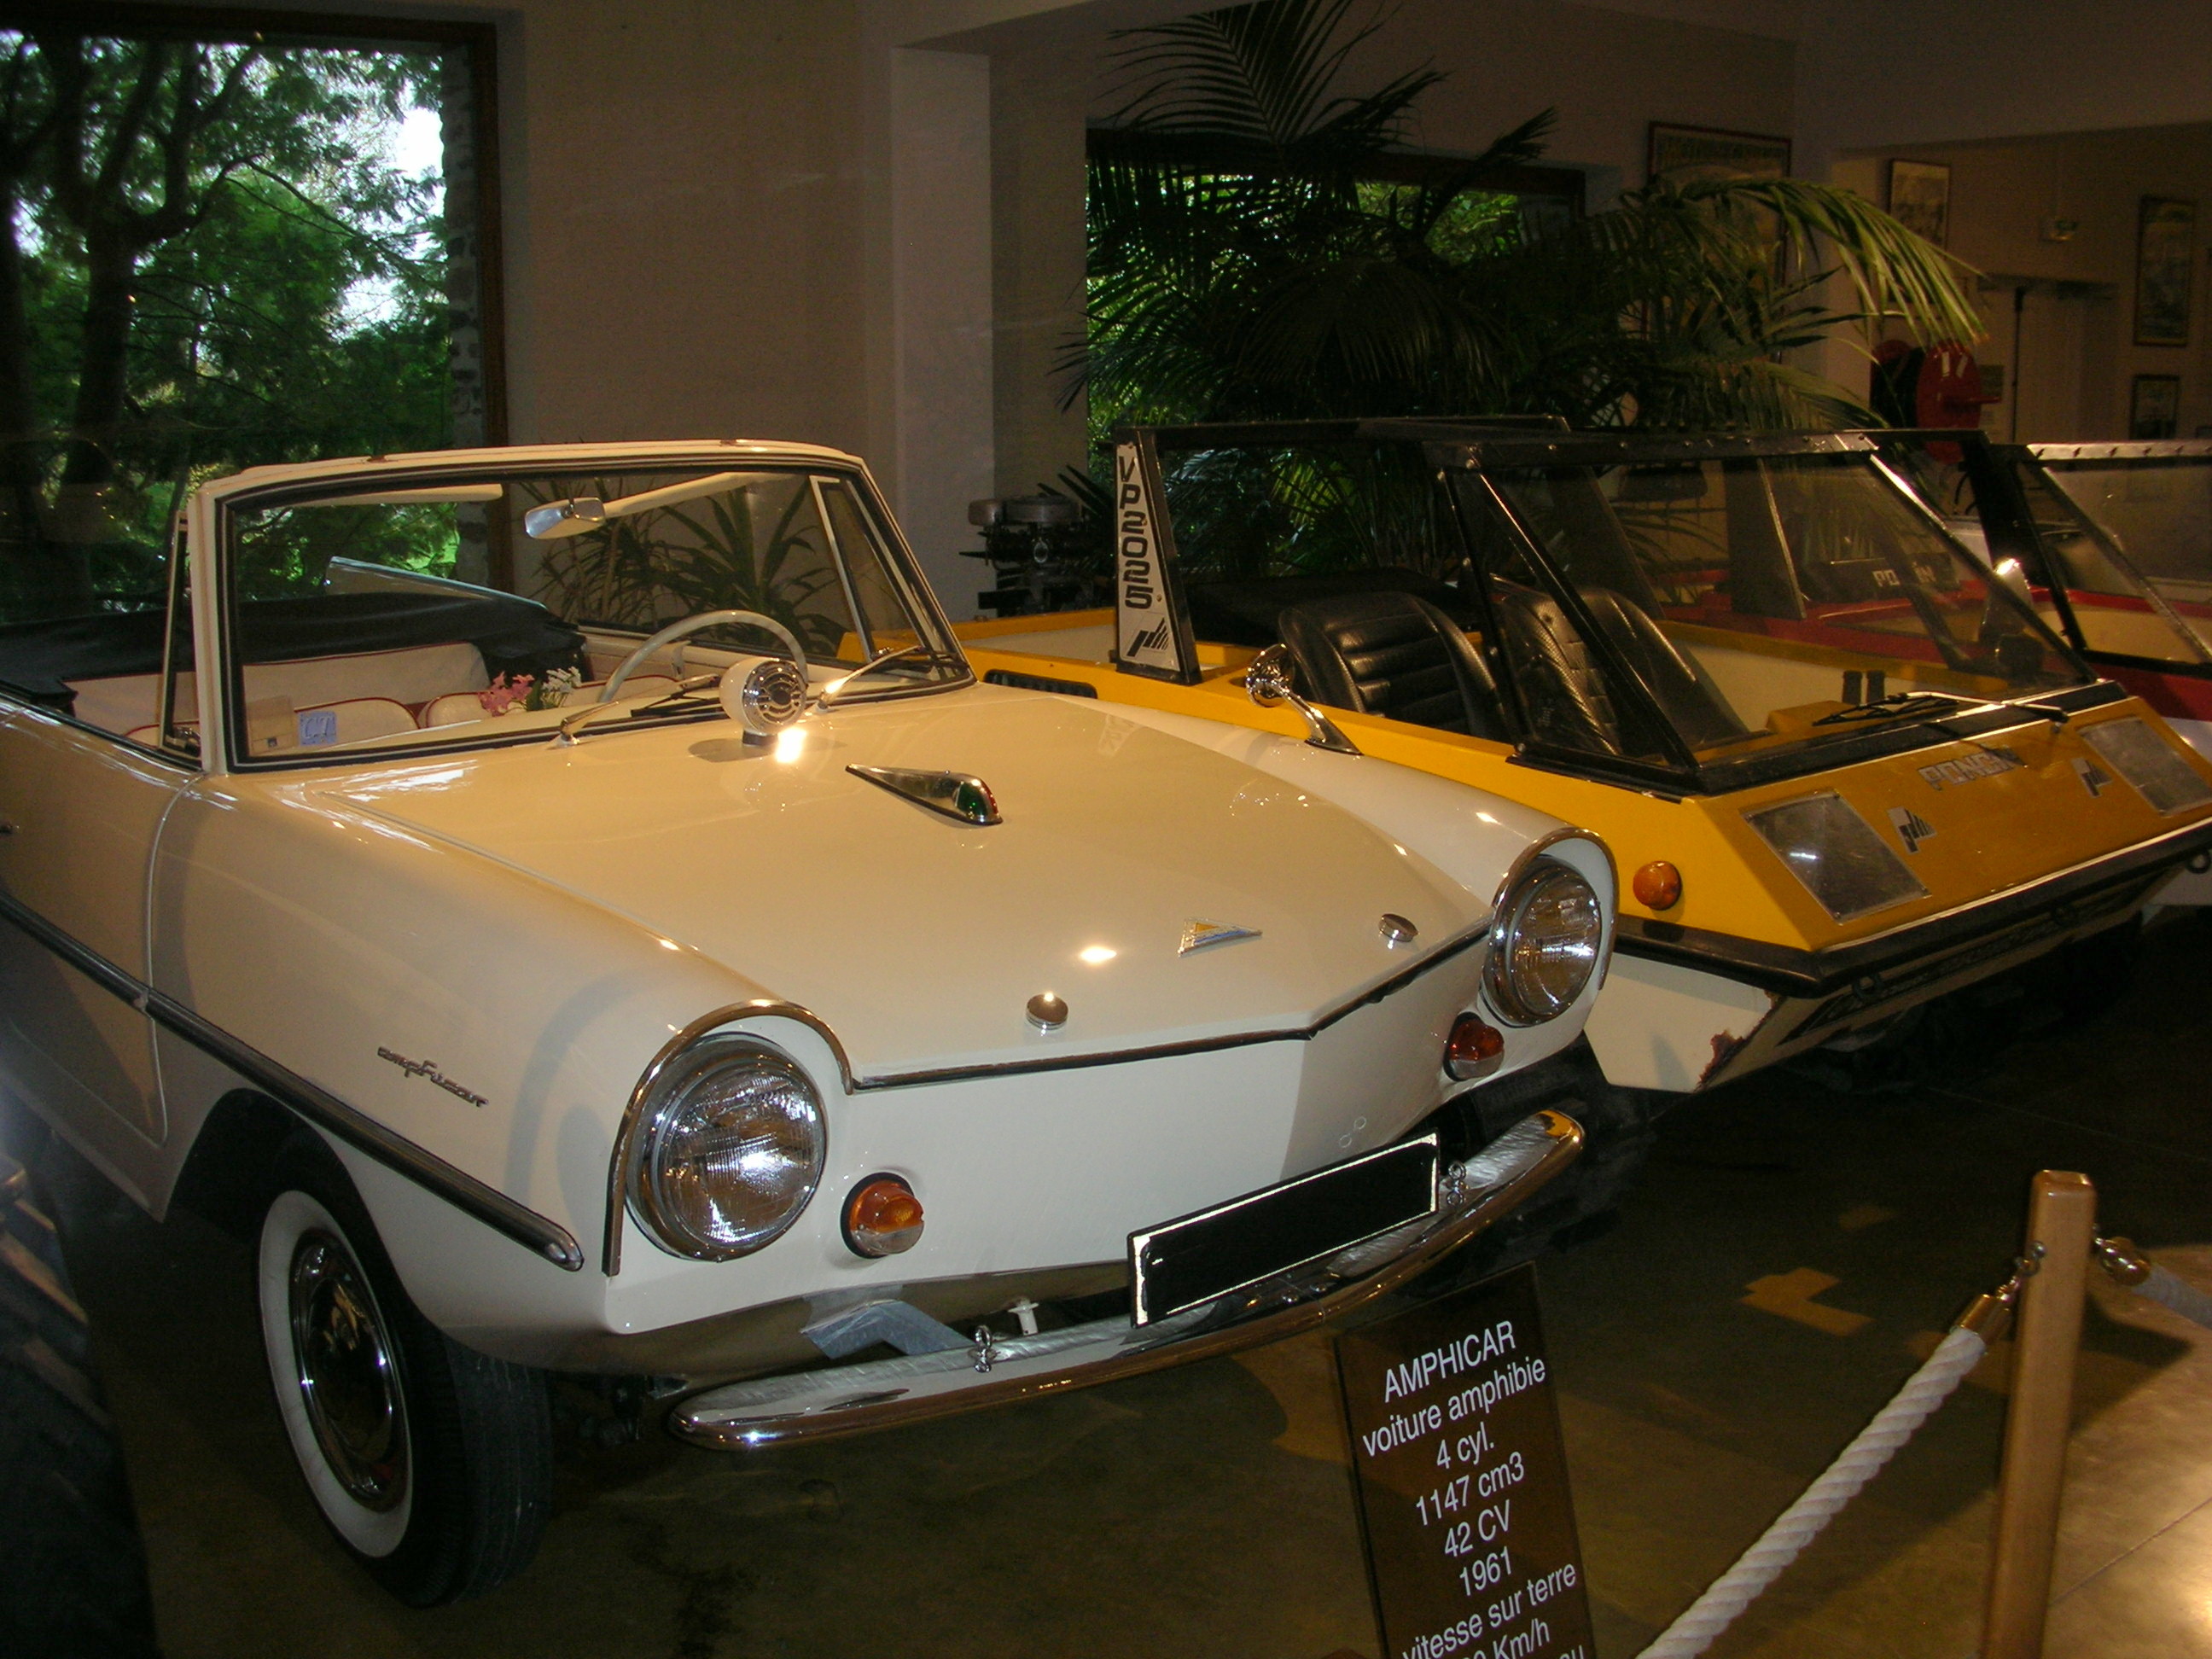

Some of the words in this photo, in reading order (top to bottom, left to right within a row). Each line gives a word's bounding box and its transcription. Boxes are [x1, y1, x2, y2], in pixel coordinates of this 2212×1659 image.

[1118, 455, 1154, 610] VP2025
[1384, 1319, 1516, 1404] AMPHICAR
[1362, 1404, 1442, 1458] voiture
[1448, 1355, 1546, 1414] amphibie
[1436, 1439, 1451, 1470] 4
[1457, 1421, 1495, 1465] cyl.
[1416, 1475, 1470, 1526] 1147
[1478, 1451, 1525, 1497] cm3
[1444, 1521, 1474, 1557] 42
[1477, 1499, 1511, 1541] CV
[1459, 1545, 1512, 1596] 1961
[1488, 1590, 1522, 1628] sur
[1526, 1563, 1577, 1607] terre
[1493, 1617, 1551, 1659] Km/h
